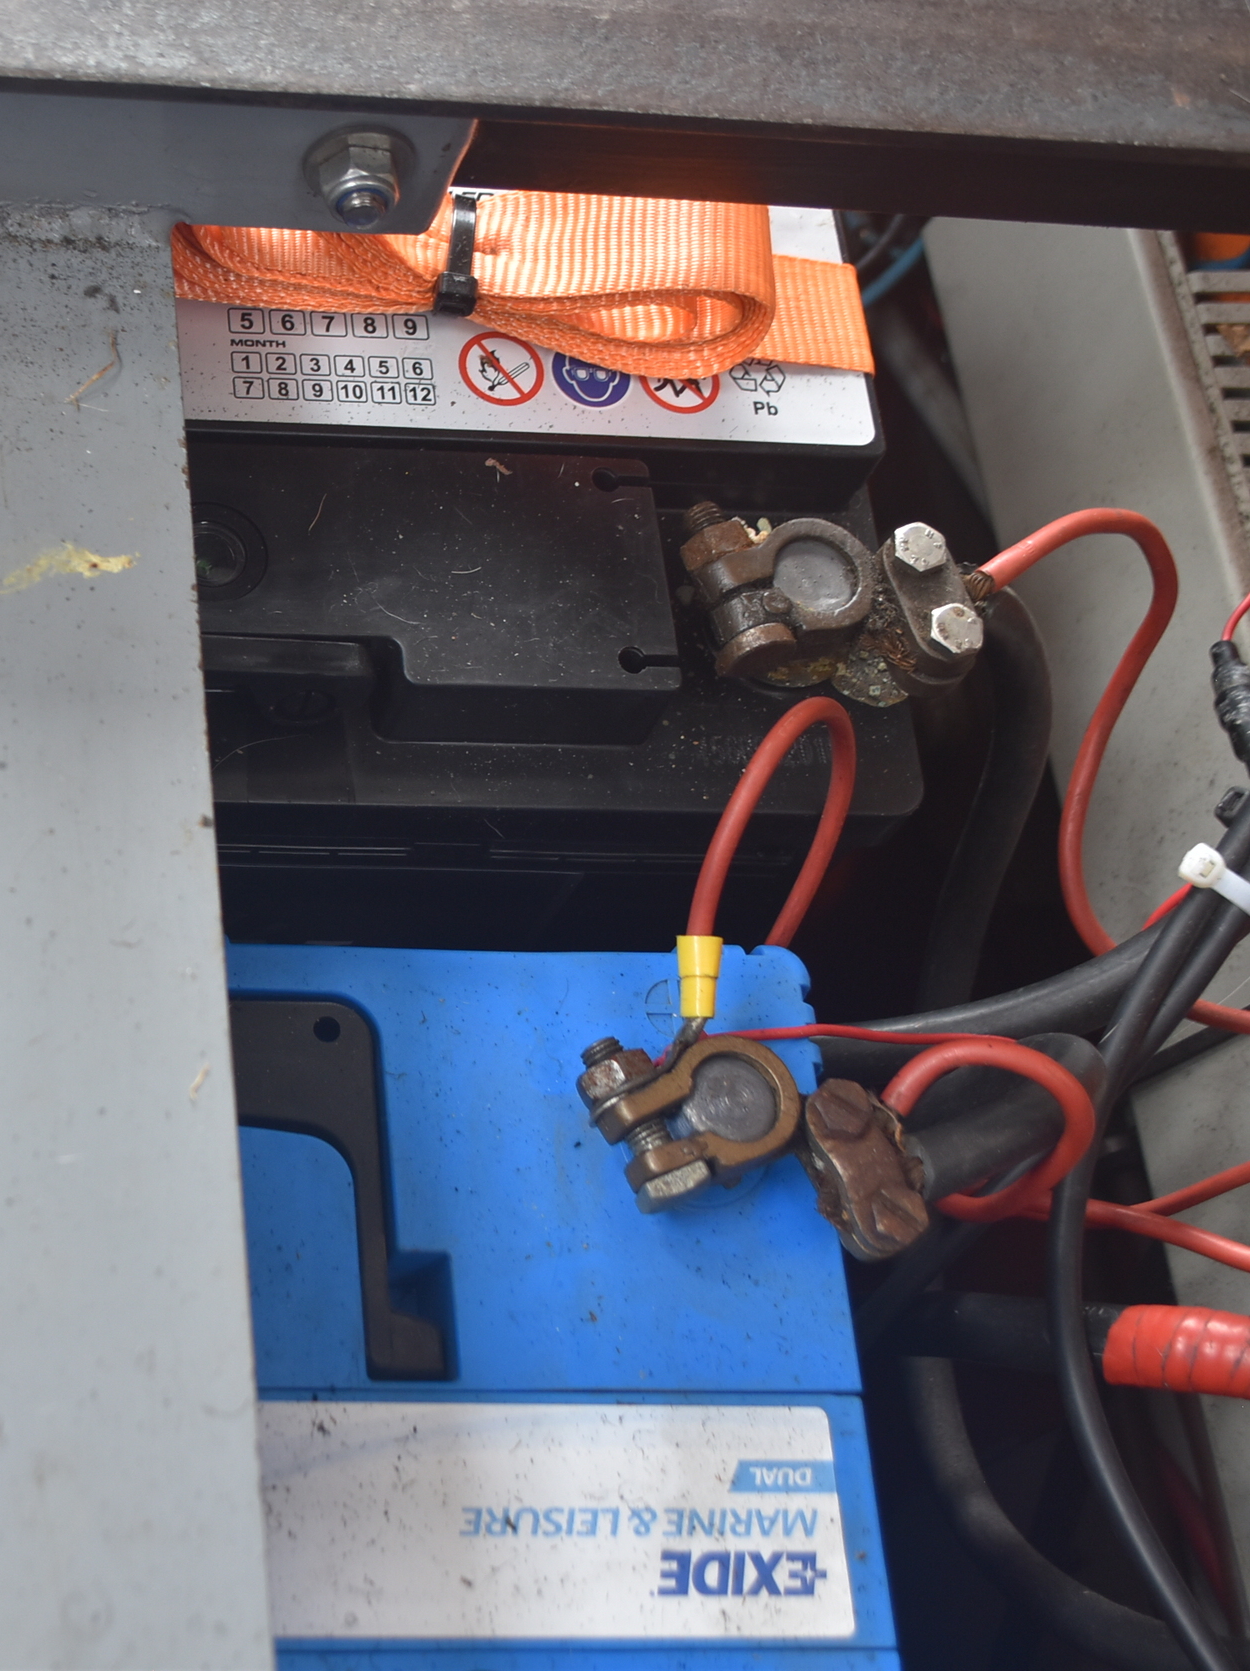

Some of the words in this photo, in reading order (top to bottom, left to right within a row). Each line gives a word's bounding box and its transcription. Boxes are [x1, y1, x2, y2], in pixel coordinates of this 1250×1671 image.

[240, 312, 254, 331] 5
[281, 313, 295, 332] 6
[321, 315, 335, 333] 7
[363, 316, 377, 335] 8
[403, 318, 418, 336] 9
[230, 338, 287, 349] MONTH
[241, 354, 251, 371] 1
[274, 356, 287, 372] 2
[309, 357, 321, 373] 3
[343, 358, 356, 374] 4
[377, 360, 390, 375] 5
[412, 361, 424, 377] 6
[242, 380, 254, 396] 7
[278, 381, 289, 397] 8
[311, 382, 324, 398] 9
[340, 384, 364, 400] 10
[376, 385, 397, 401] 11
[408, 386, 432, 402] 12
[753, 400, 779, 416] Pb
[749, 1465, 813, 1487] DUAL
[459, 1506, 620, 1537] LEISURE
[630, 1507, 657, 1537] &
[662, 1507, 818, 1538] MARINE
[657, 1549, 827, 1598] EXIDE
